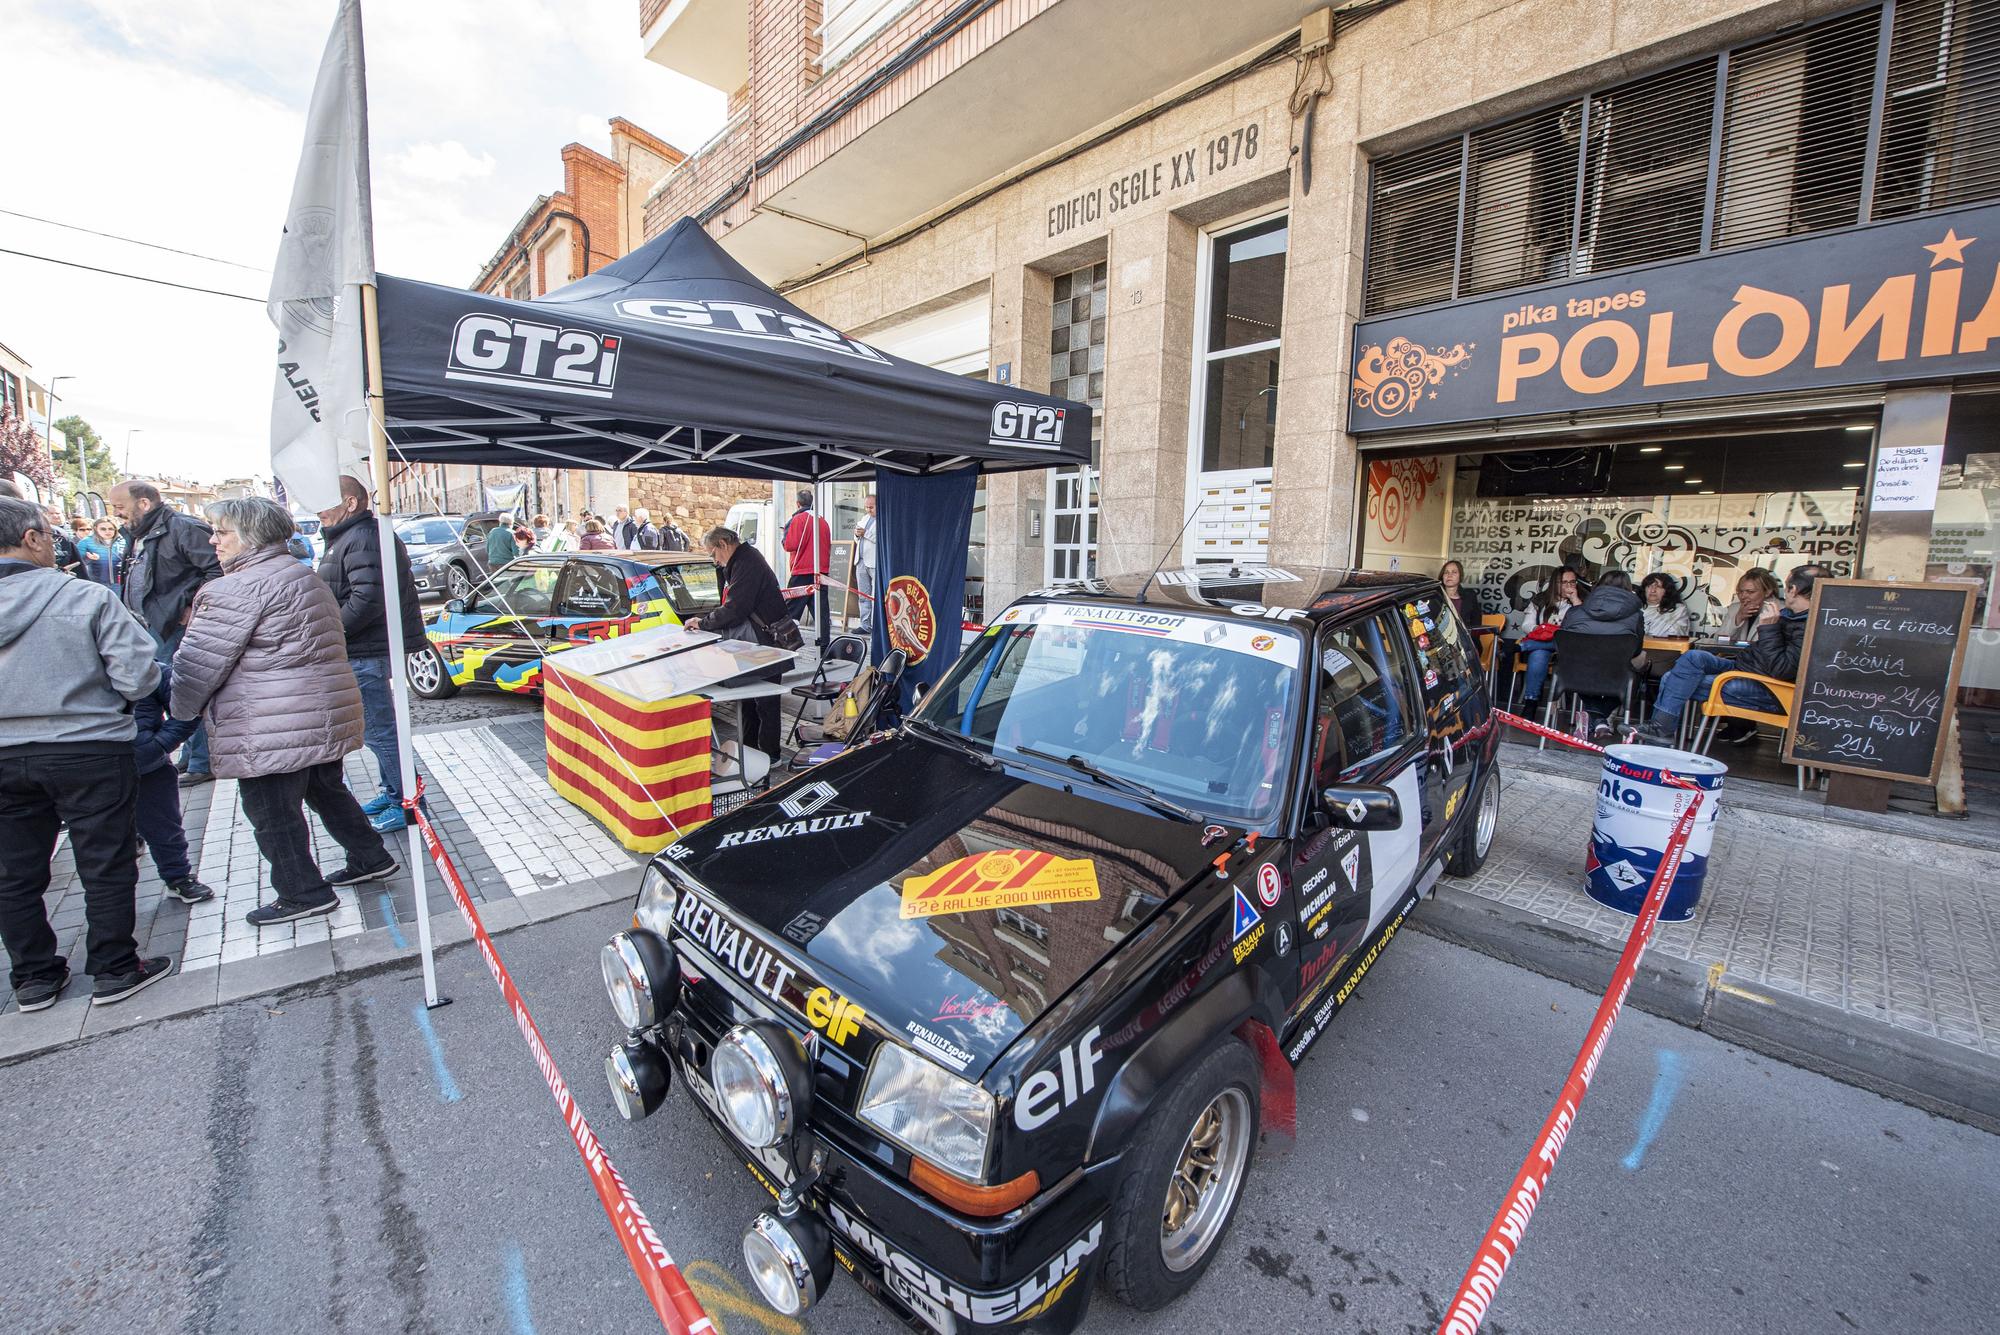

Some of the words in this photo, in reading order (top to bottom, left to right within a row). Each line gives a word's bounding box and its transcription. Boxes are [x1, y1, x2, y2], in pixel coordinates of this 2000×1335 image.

[1048, 188, 1101, 238] EDIFICI
[1109, 162, 1161, 214] SEGLE
[1170, 148, 1196, 190] XX
[1206, 123, 1259, 176] 1978
[1130, 290, 1143, 304] 13
[1502, 304, 1558, 334] pika
[1567, 289, 1647, 319] tapes
[633, 301, 885, 362] GT2i
[455, 316, 617, 385] GT2i
[993, 404, 1065, 443] GT2i
[907, 584, 925, 608] BIELA
[1231, 604, 1310, 621] elf
[918, 609, 928, 641] CLUB
[1064, 607, 1186, 628] RENAULTsport
[1821, 608, 1867, 629] TORNA
[1873, 619, 1892, 631] EL
[1856, 635, 1877, 648] AL
[1813, 682, 1886, 708] Diumenge
[1891, 686, 1941, 716] 24/4
[1869, 715, 1904, 739] Rayo
[716, 811, 871, 849] RENAULT
[667, 844, 694, 860] elf
[1302, 867, 1328, 896] RECARO
[908, 899, 940, 915] 52è
[943, 895, 991, 911] RALLYE
[995, 891, 1028, 905] 2000
[1300, 881, 1337, 923] MICHELIN
[675, 890, 796, 1001] RENAULT
[1232, 922, 1265, 959] RENAULT
[1301, 940, 1337, 988] Turbo
[1336, 945, 1378, 1006] RENAULT
[1377, 913, 1403, 951] rallyes
[807, 986, 866, 1047] elf
[1314, 995, 1335, 1025] RENAULT
[906, 1020, 975, 1063] RENAULTsport
[1290, 1026, 1316, 1061] speedline
[1014, 1025, 1104, 1131] elf
[829, 1202, 1103, 1324] MICHELIN
